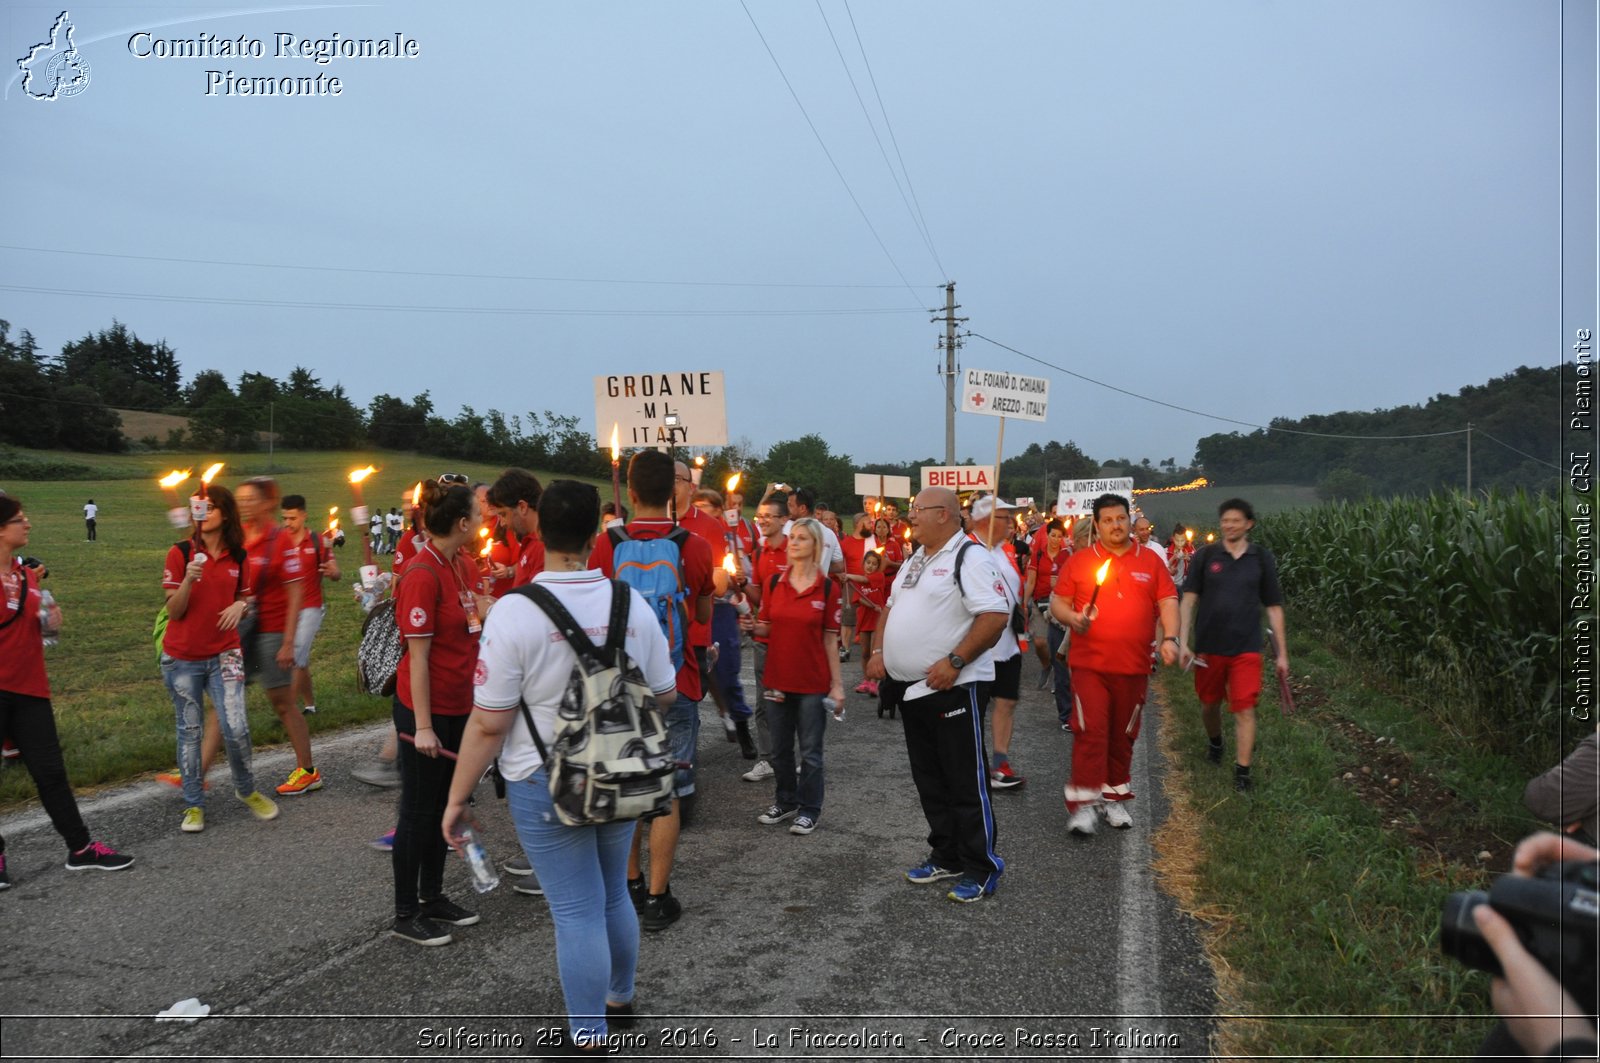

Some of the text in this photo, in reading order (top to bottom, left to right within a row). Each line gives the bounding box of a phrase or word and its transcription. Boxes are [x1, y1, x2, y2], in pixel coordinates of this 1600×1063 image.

[607, 372, 711, 398] GROANE
[968, 371, 982, 386] C.L.
[1011, 376, 1018, 391] D.
[1020, 377, 1046, 395] CHIANA
[992, 396, 1020, 413] AREZZO
[1026, 400, 1047, 417] ITALY
[633, 426, 688, 443] ITAY
[929, 470, 988, 486] BIELLA
[1073, 481, 1094, 493] MONTE
[1095, 480, 1108, 492] SAN
